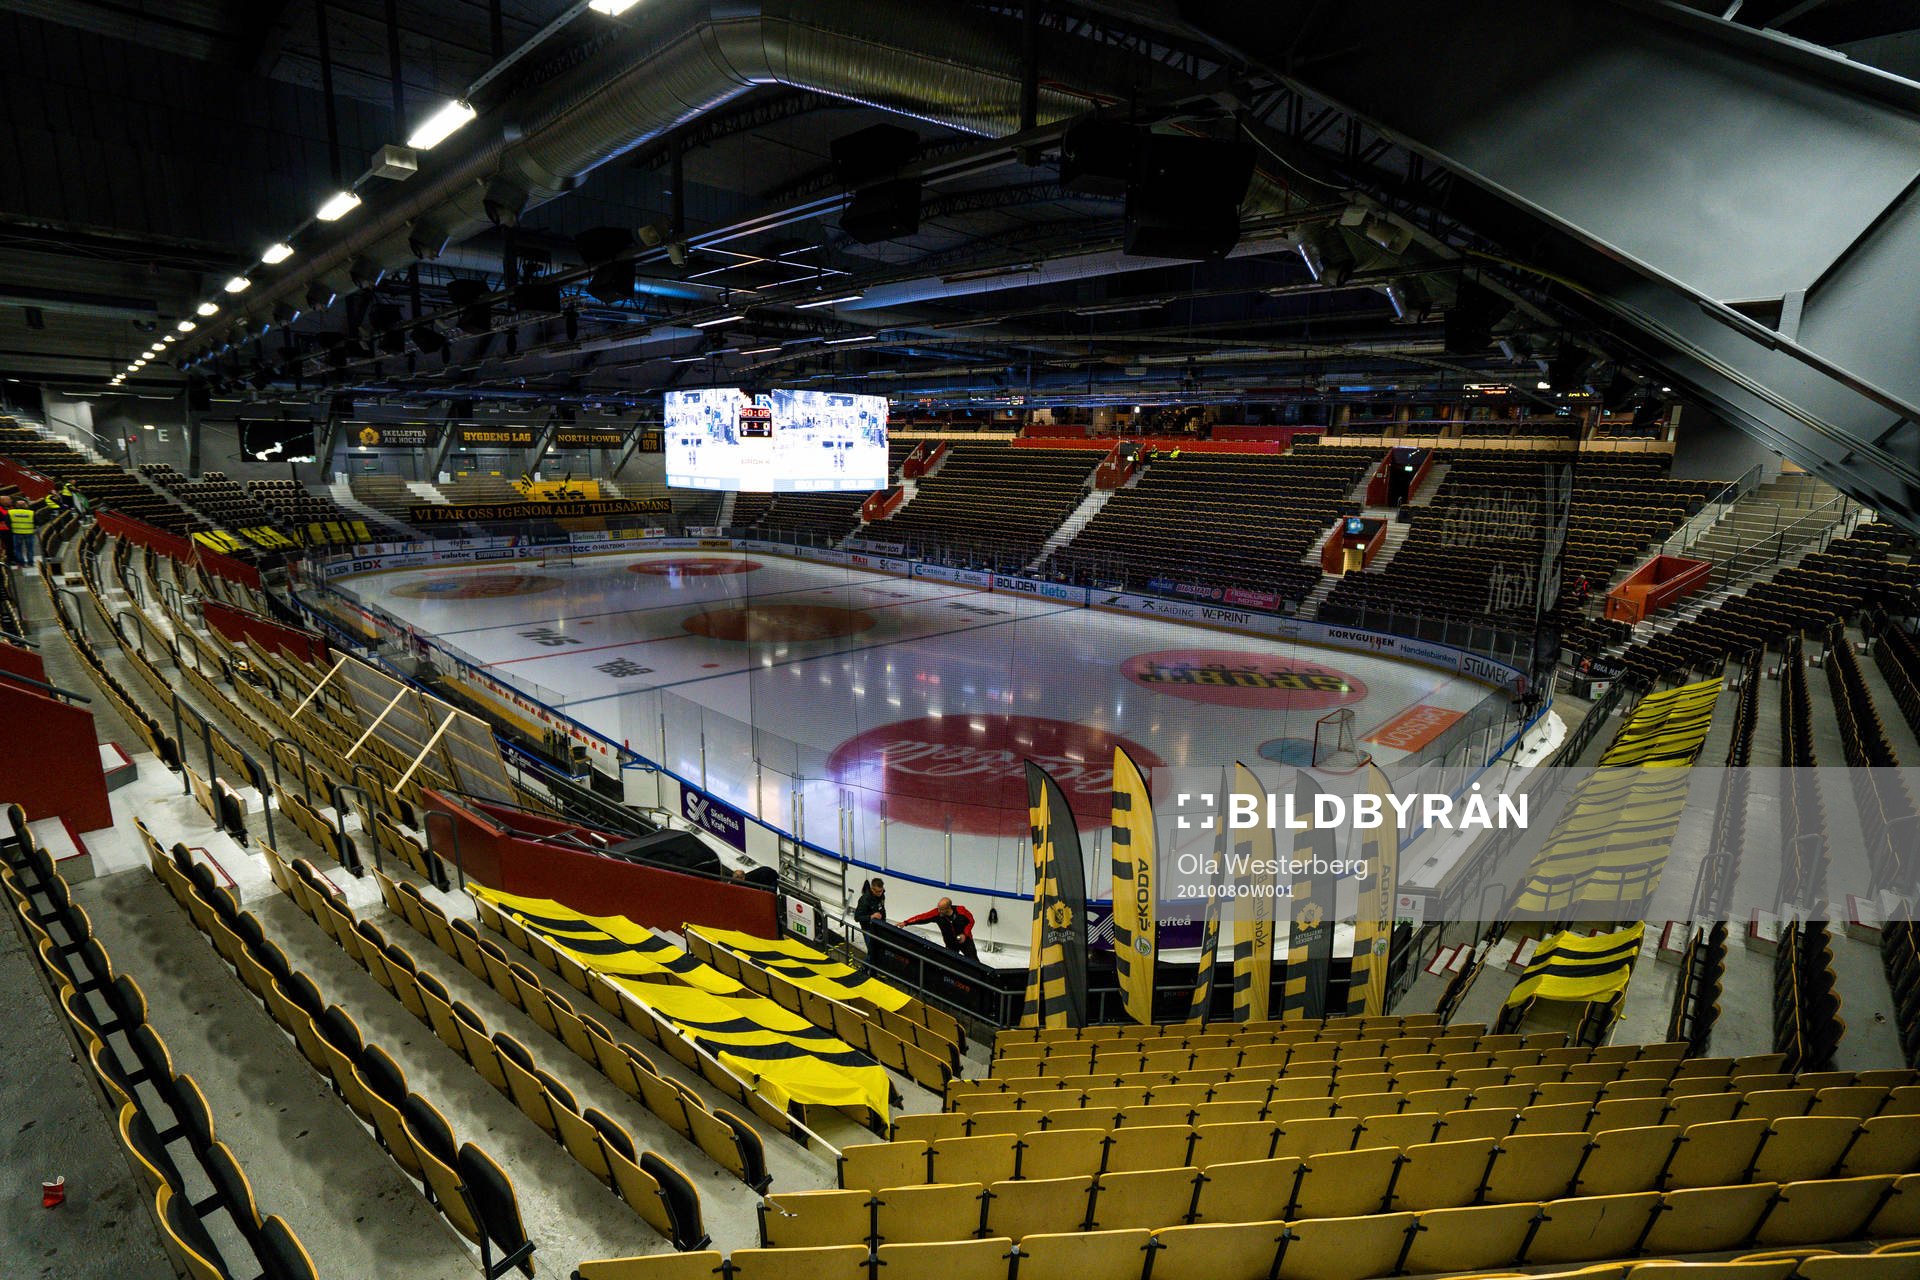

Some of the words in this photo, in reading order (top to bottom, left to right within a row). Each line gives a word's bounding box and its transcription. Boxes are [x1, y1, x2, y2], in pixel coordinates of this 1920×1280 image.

[158, 429, 170, 442] E
[382, 429, 427, 437] SKELLEFTEÅ
[463, 431, 510, 441] BYGDENS
[512, 432, 532, 442] LAG
[557, 434, 590, 443] NORTH
[591, 434, 621, 443] POWER
[415, 509, 432, 521] VI
[436, 509, 464, 521] TAR
[468, 508, 494, 519] OSS
[497, 504, 552, 518] IGENOM
[556, 502, 587, 516] ALLT
[590, 499, 670, 514] TILLSAMMANS
[353, 559, 381, 572] BDX
[1158, 605, 1194, 617] KAIDING
[1401, 644, 1457, 664] Handelsbanken
[1138, 665, 1356, 692] SPORT
[710, 808, 739, 831] Skellefteå
[710, 818, 726, 833] Kraft
